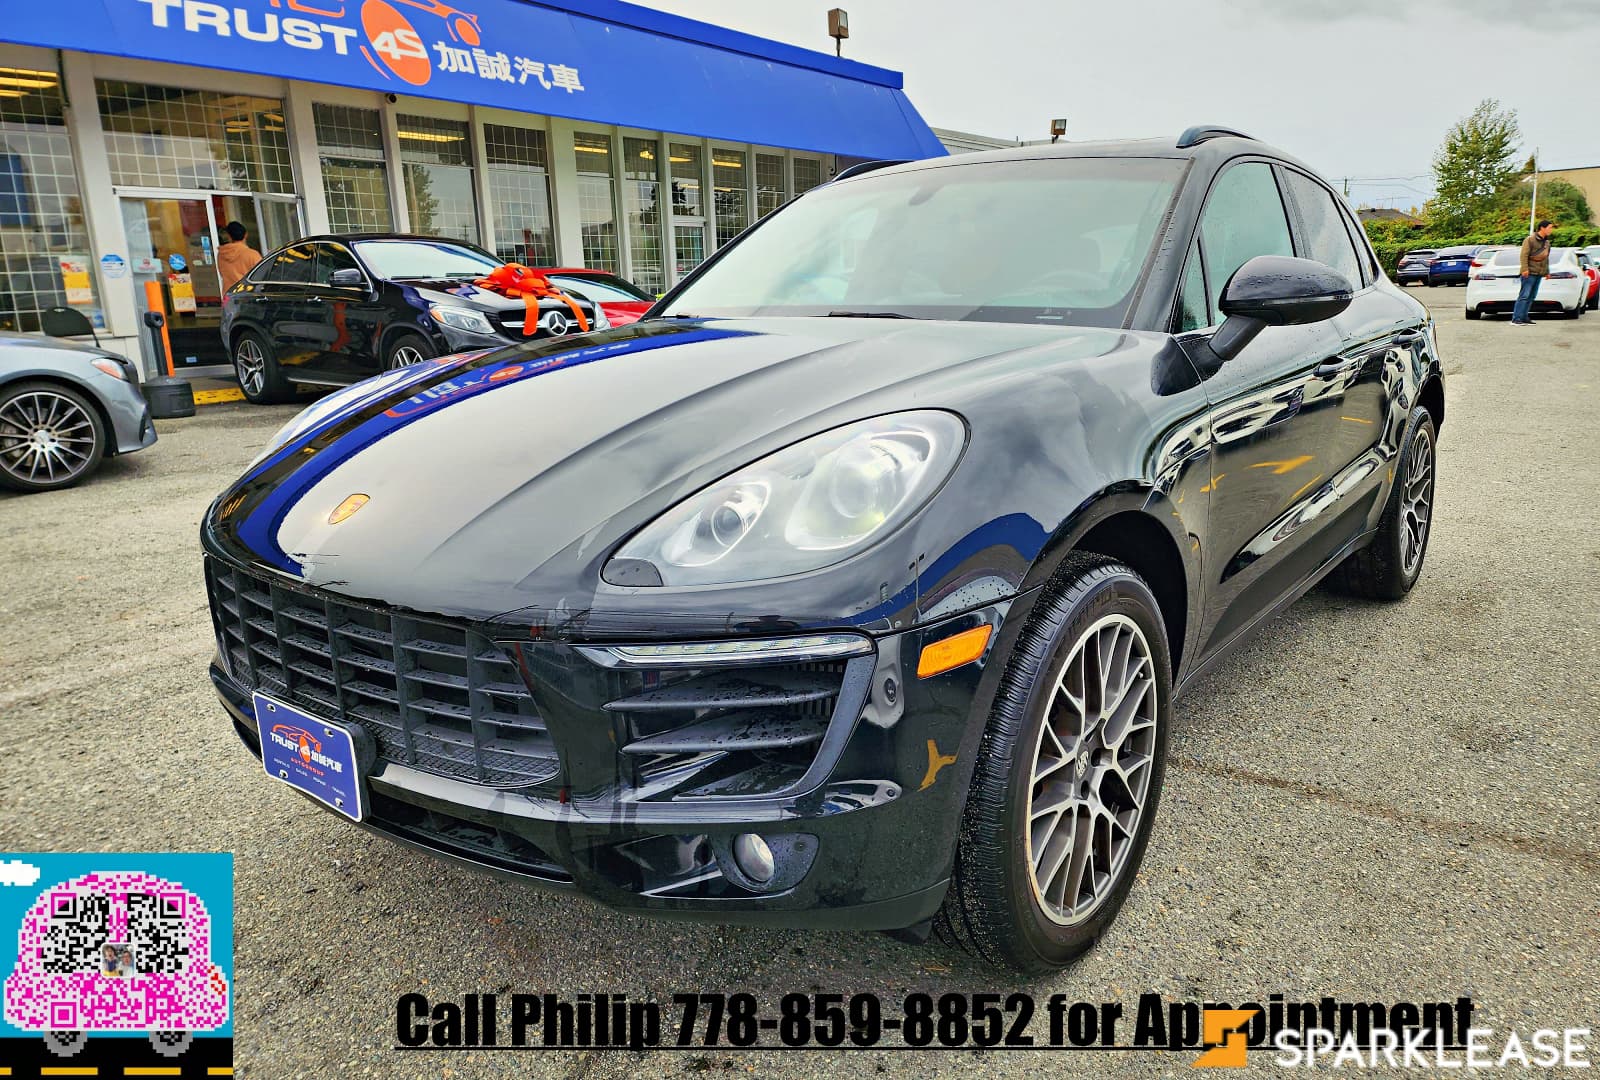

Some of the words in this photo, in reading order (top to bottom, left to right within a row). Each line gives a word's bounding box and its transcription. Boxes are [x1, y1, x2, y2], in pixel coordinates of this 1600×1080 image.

[140, 0, 358, 56] TRUST
[371, 28, 428, 60] 4S
[432, 41, 585, 93] 加誠汽車
[269, 731, 299, 752] TRUST
